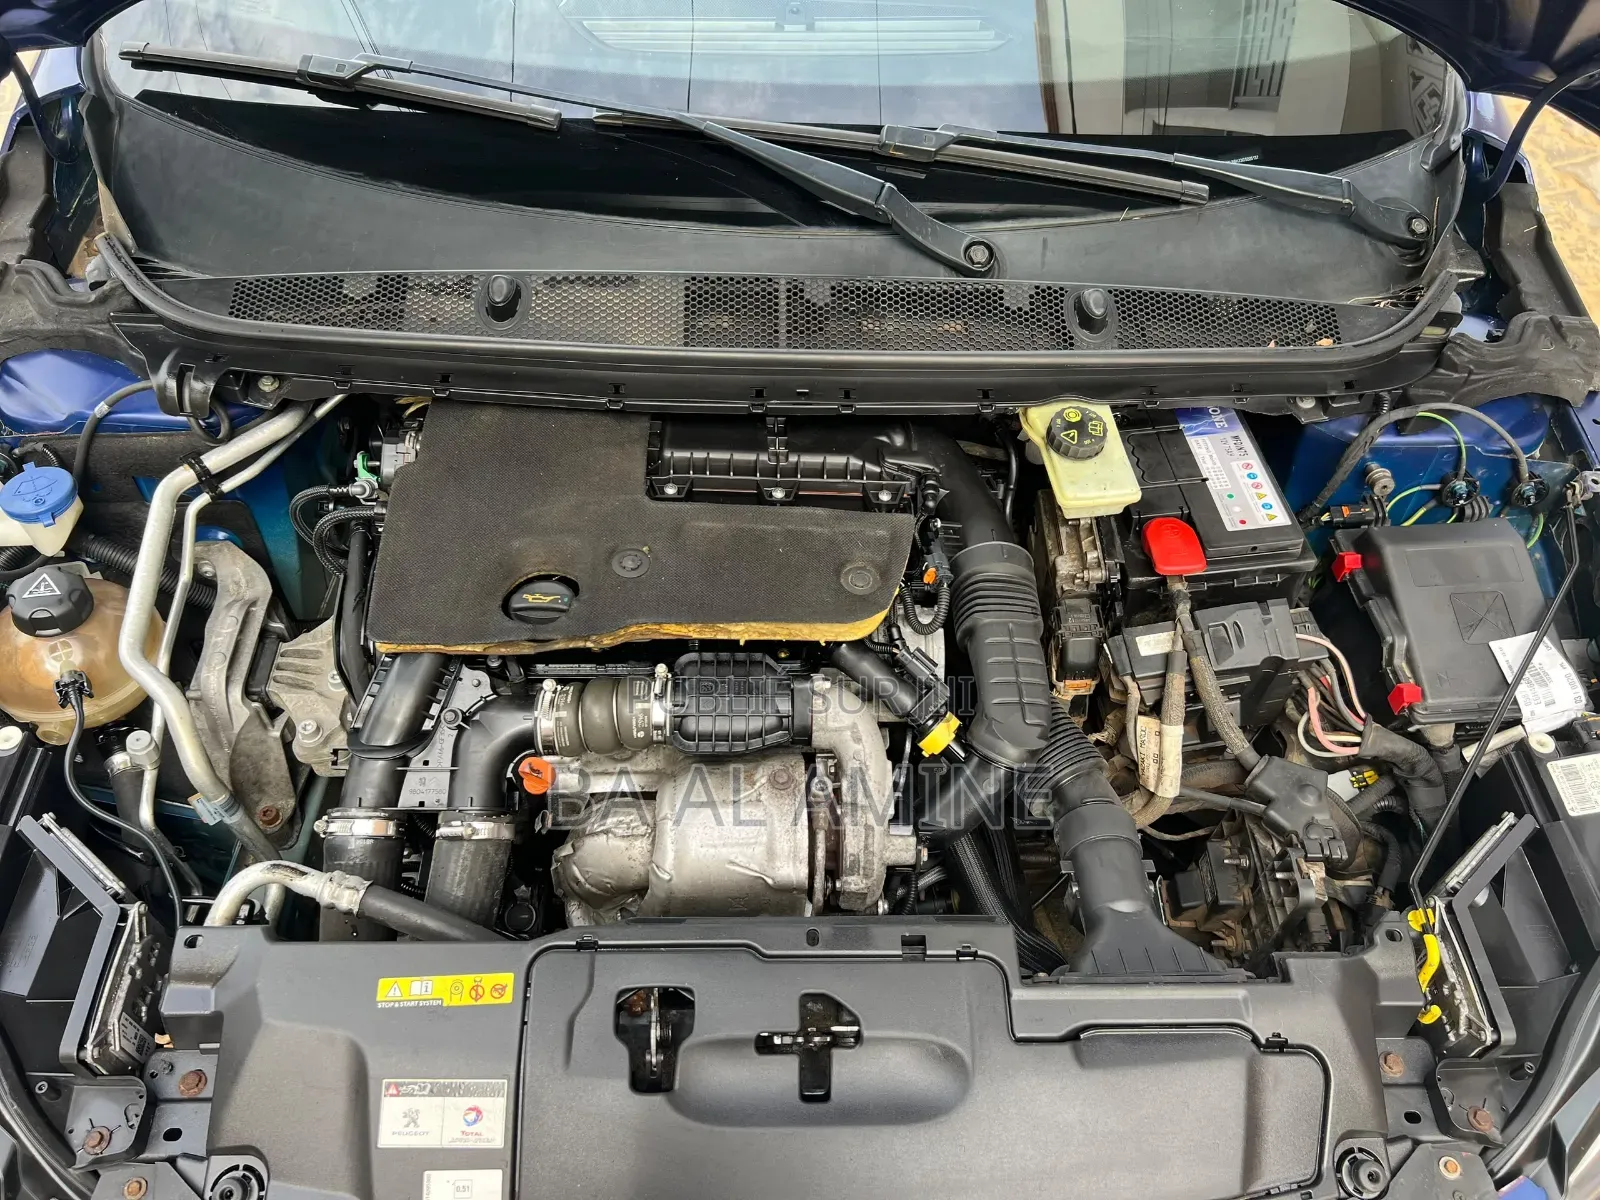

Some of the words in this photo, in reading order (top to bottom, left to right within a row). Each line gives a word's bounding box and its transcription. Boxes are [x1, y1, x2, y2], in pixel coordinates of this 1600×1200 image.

[376, 1001, 394, 1009] STOP
[399, 1000, 419, 1008] START
[419, 999, 442, 1007] SYSTEM
